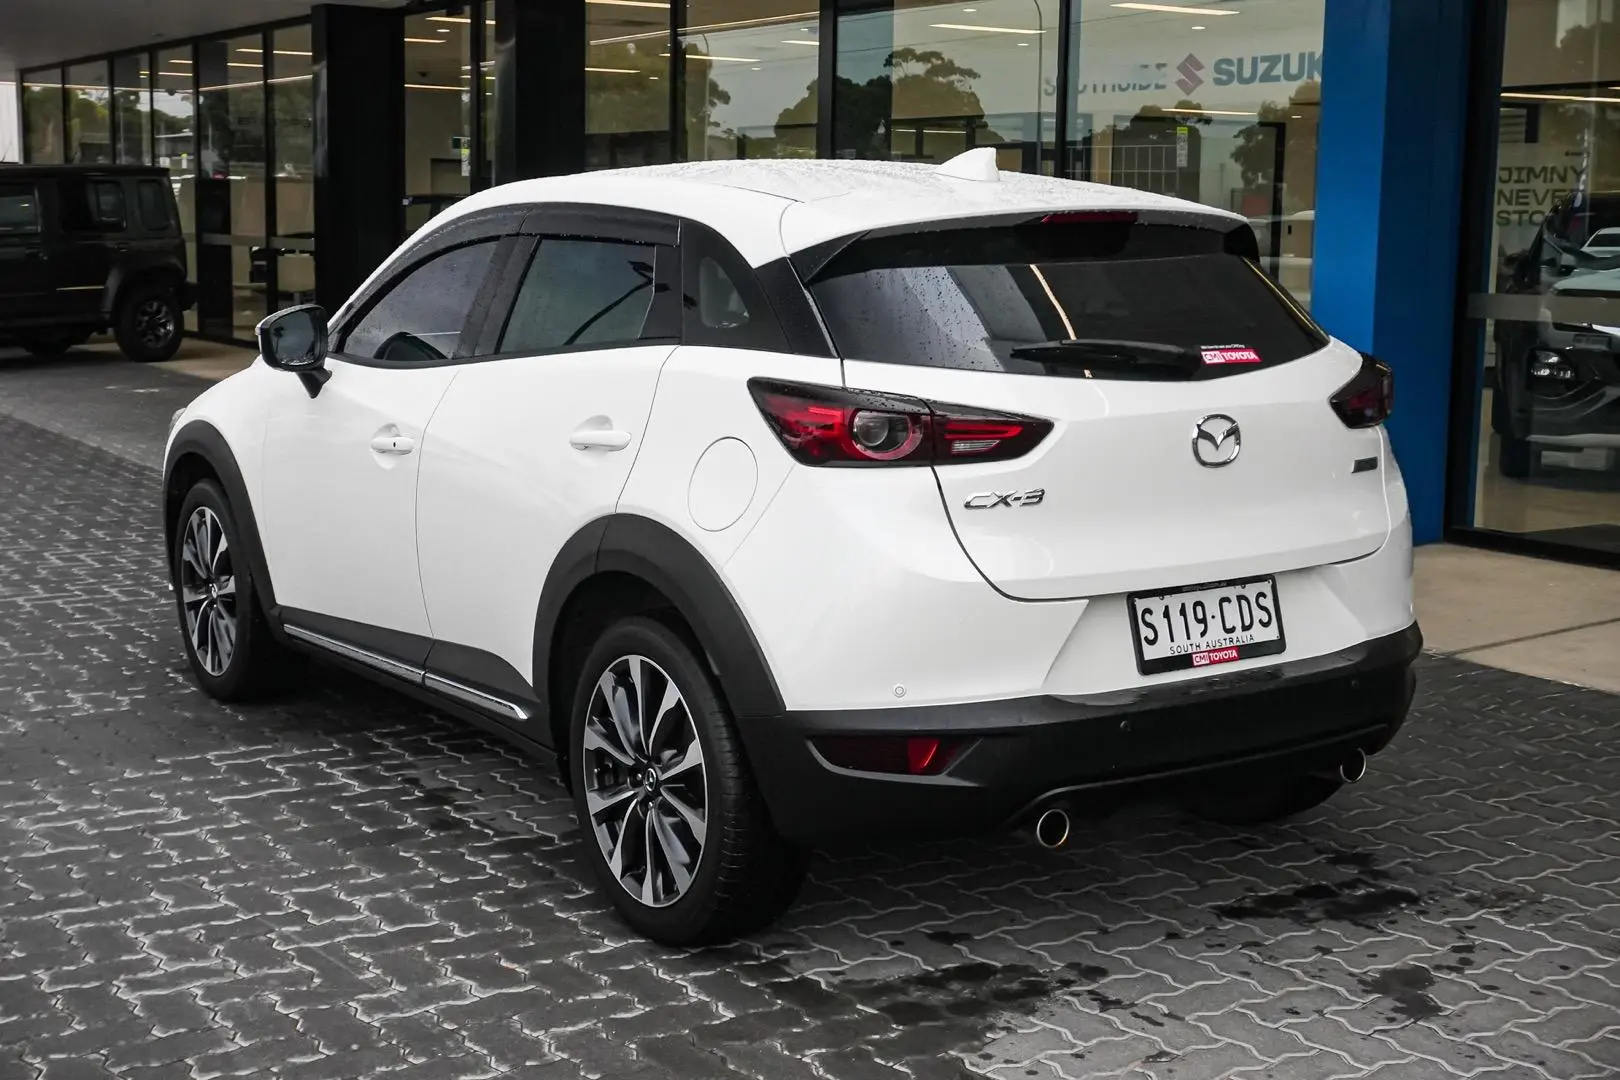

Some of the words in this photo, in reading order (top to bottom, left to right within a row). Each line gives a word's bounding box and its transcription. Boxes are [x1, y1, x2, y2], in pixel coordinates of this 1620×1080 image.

[1213, 51, 1321, 86] SUZUK
[1498, 165, 1587, 184] JIMNY
[1497, 189, 1576, 206] NEVE
[1495, 209, 1546, 227] STO
[963, 488, 1045, 509] CX-3
[1169, 642, 1201, 655] SOUTH
[1205, 634, 1255, 649] AUSTRALIA
[1208, 649, 1238, 661] TOYOTA
